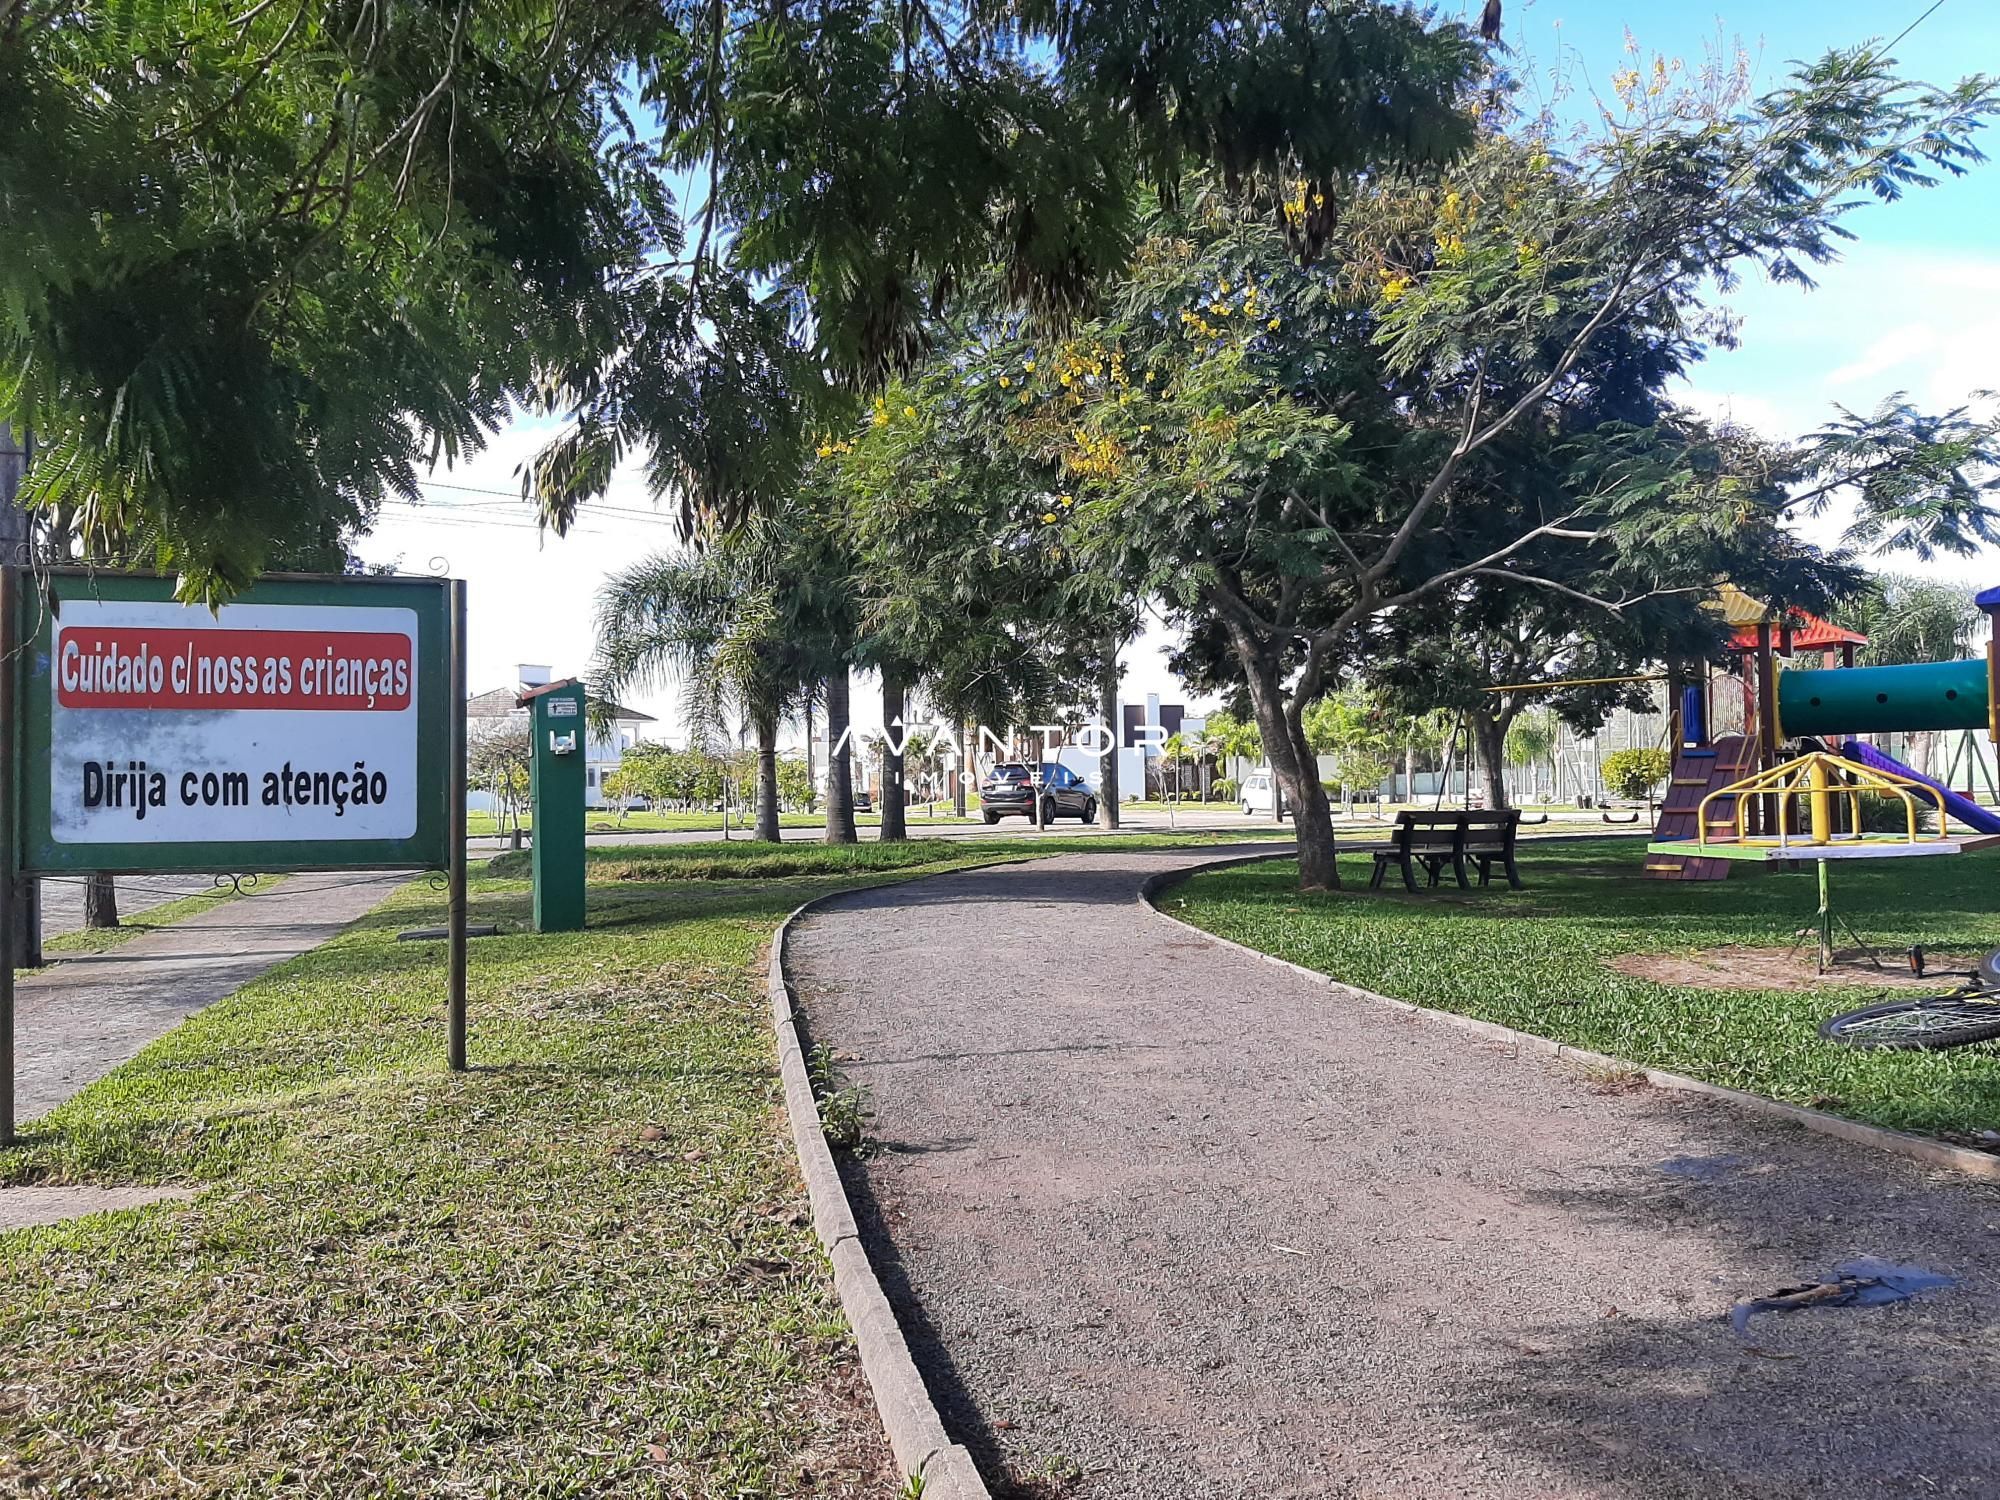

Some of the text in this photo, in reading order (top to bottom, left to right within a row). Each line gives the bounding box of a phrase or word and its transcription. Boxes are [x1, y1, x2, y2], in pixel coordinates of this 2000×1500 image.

[61, 640, 163, 693] Cuidado
[299, 646, 408, 709] crianças
[84, 761, 387, 820] Dirija com atenção
